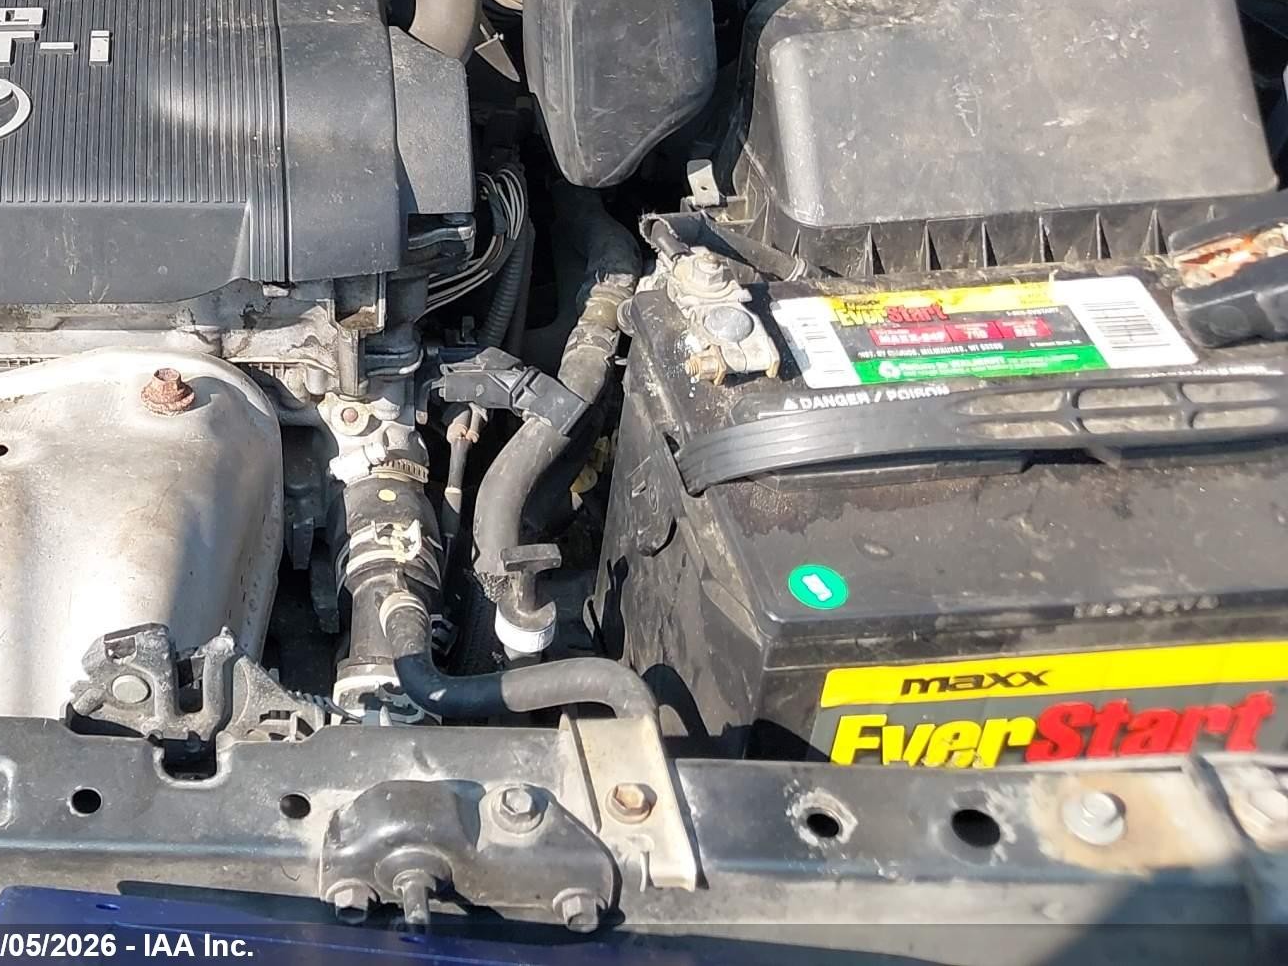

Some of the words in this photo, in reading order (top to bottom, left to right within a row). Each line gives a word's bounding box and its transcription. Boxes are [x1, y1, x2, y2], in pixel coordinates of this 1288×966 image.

[833, 301, 950, 327] EverStart
[800, 391, 870, 410] DANGER
[900, 670, 1049, 696] maxx
[830, 690, 1274, 769] EverStart
